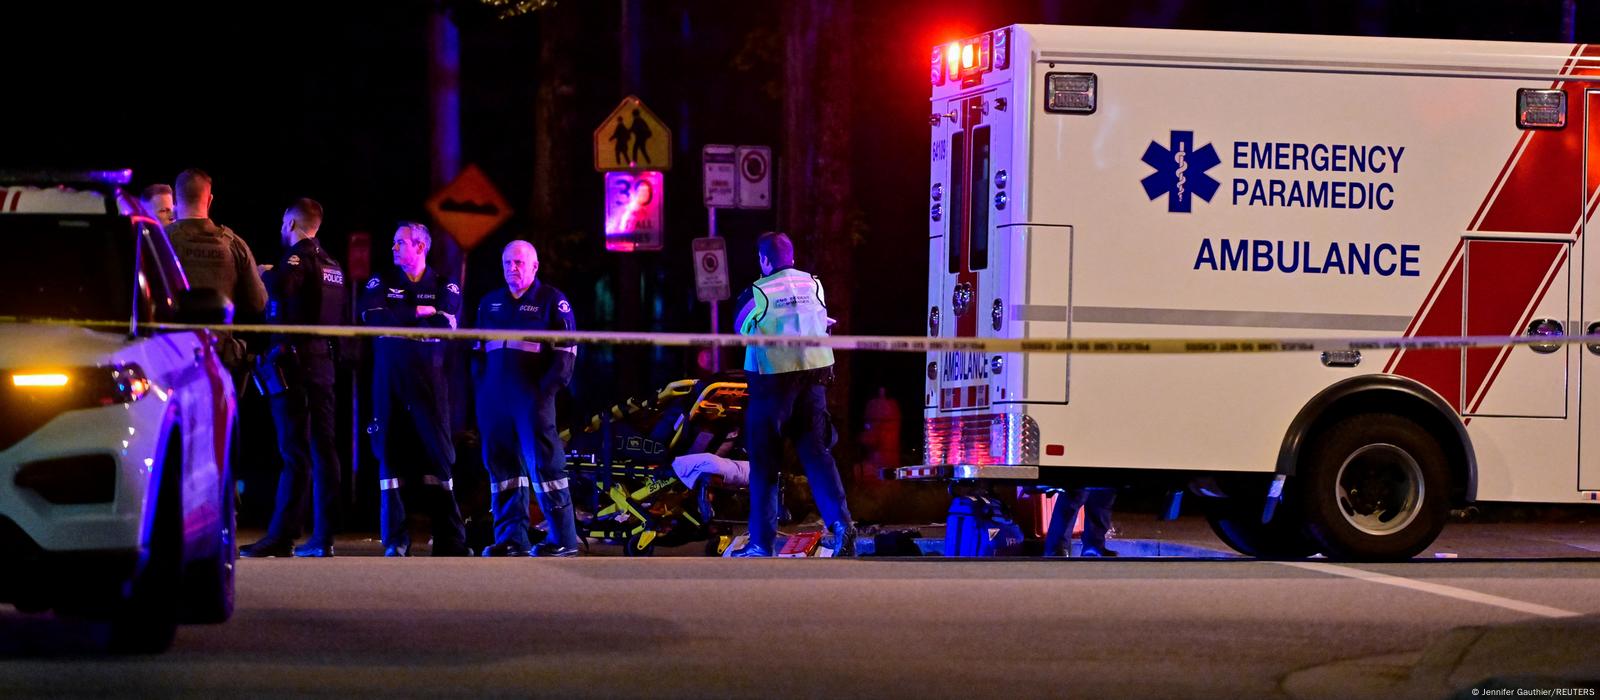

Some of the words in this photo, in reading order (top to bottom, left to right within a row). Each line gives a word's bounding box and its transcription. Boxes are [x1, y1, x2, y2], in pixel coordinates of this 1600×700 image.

[1233, 141, 1405, 173] EMERGENCY
[1232, 178, 1394, 210] PARAMEDIC
[186, 247, 225, 259] POLICE
[1193, 238, 1420, 277] AMBULANCE
[323, 272, 343, 284] POLICE
